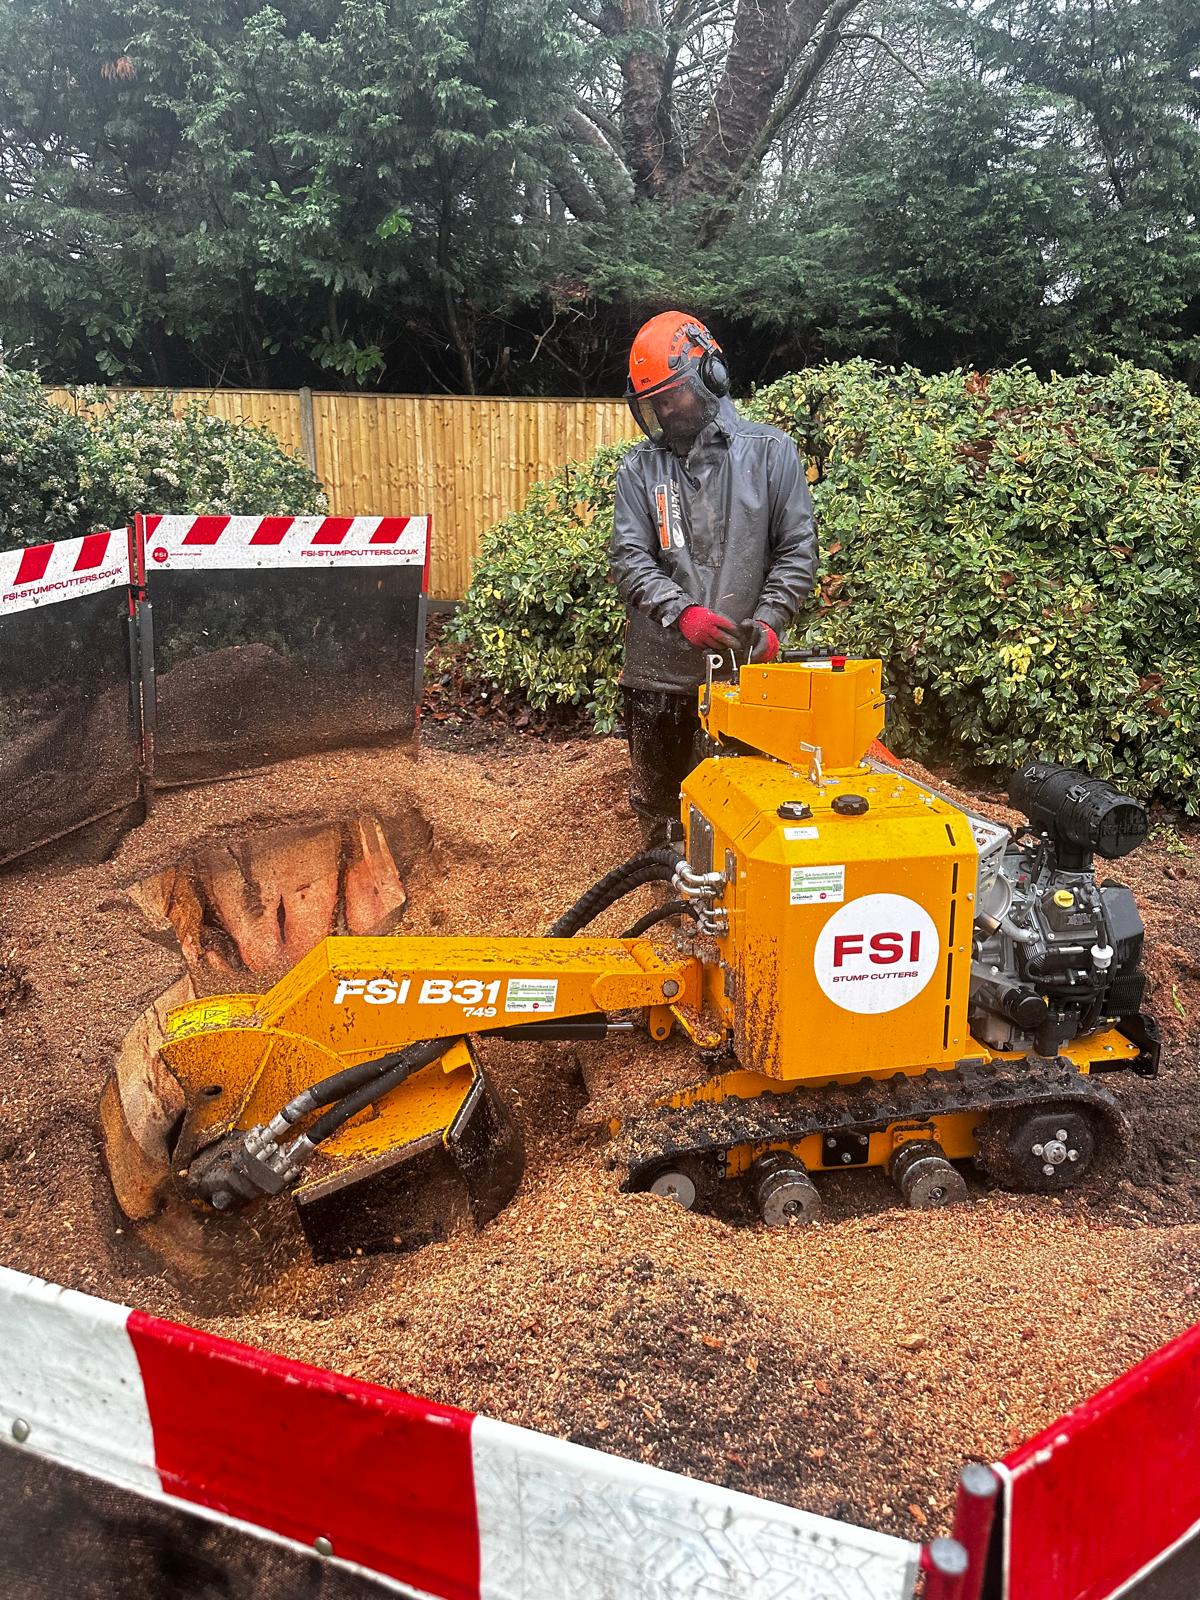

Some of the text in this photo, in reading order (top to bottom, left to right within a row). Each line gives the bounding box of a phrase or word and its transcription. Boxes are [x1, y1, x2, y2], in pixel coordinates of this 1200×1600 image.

[301, 548, 419, 557] FSI-STUMPCUTTERS.CO.UK
[2, 566, 123, 601] FSI-STUMPCUTTERS.CO.UK
[832, 930, 921, 967] FSI
[832, 971, 919, 982] STUMP CUTTERS
[333, 979, 502, 1004] FSI B31
[463, 1007, 497, 1018] 749
